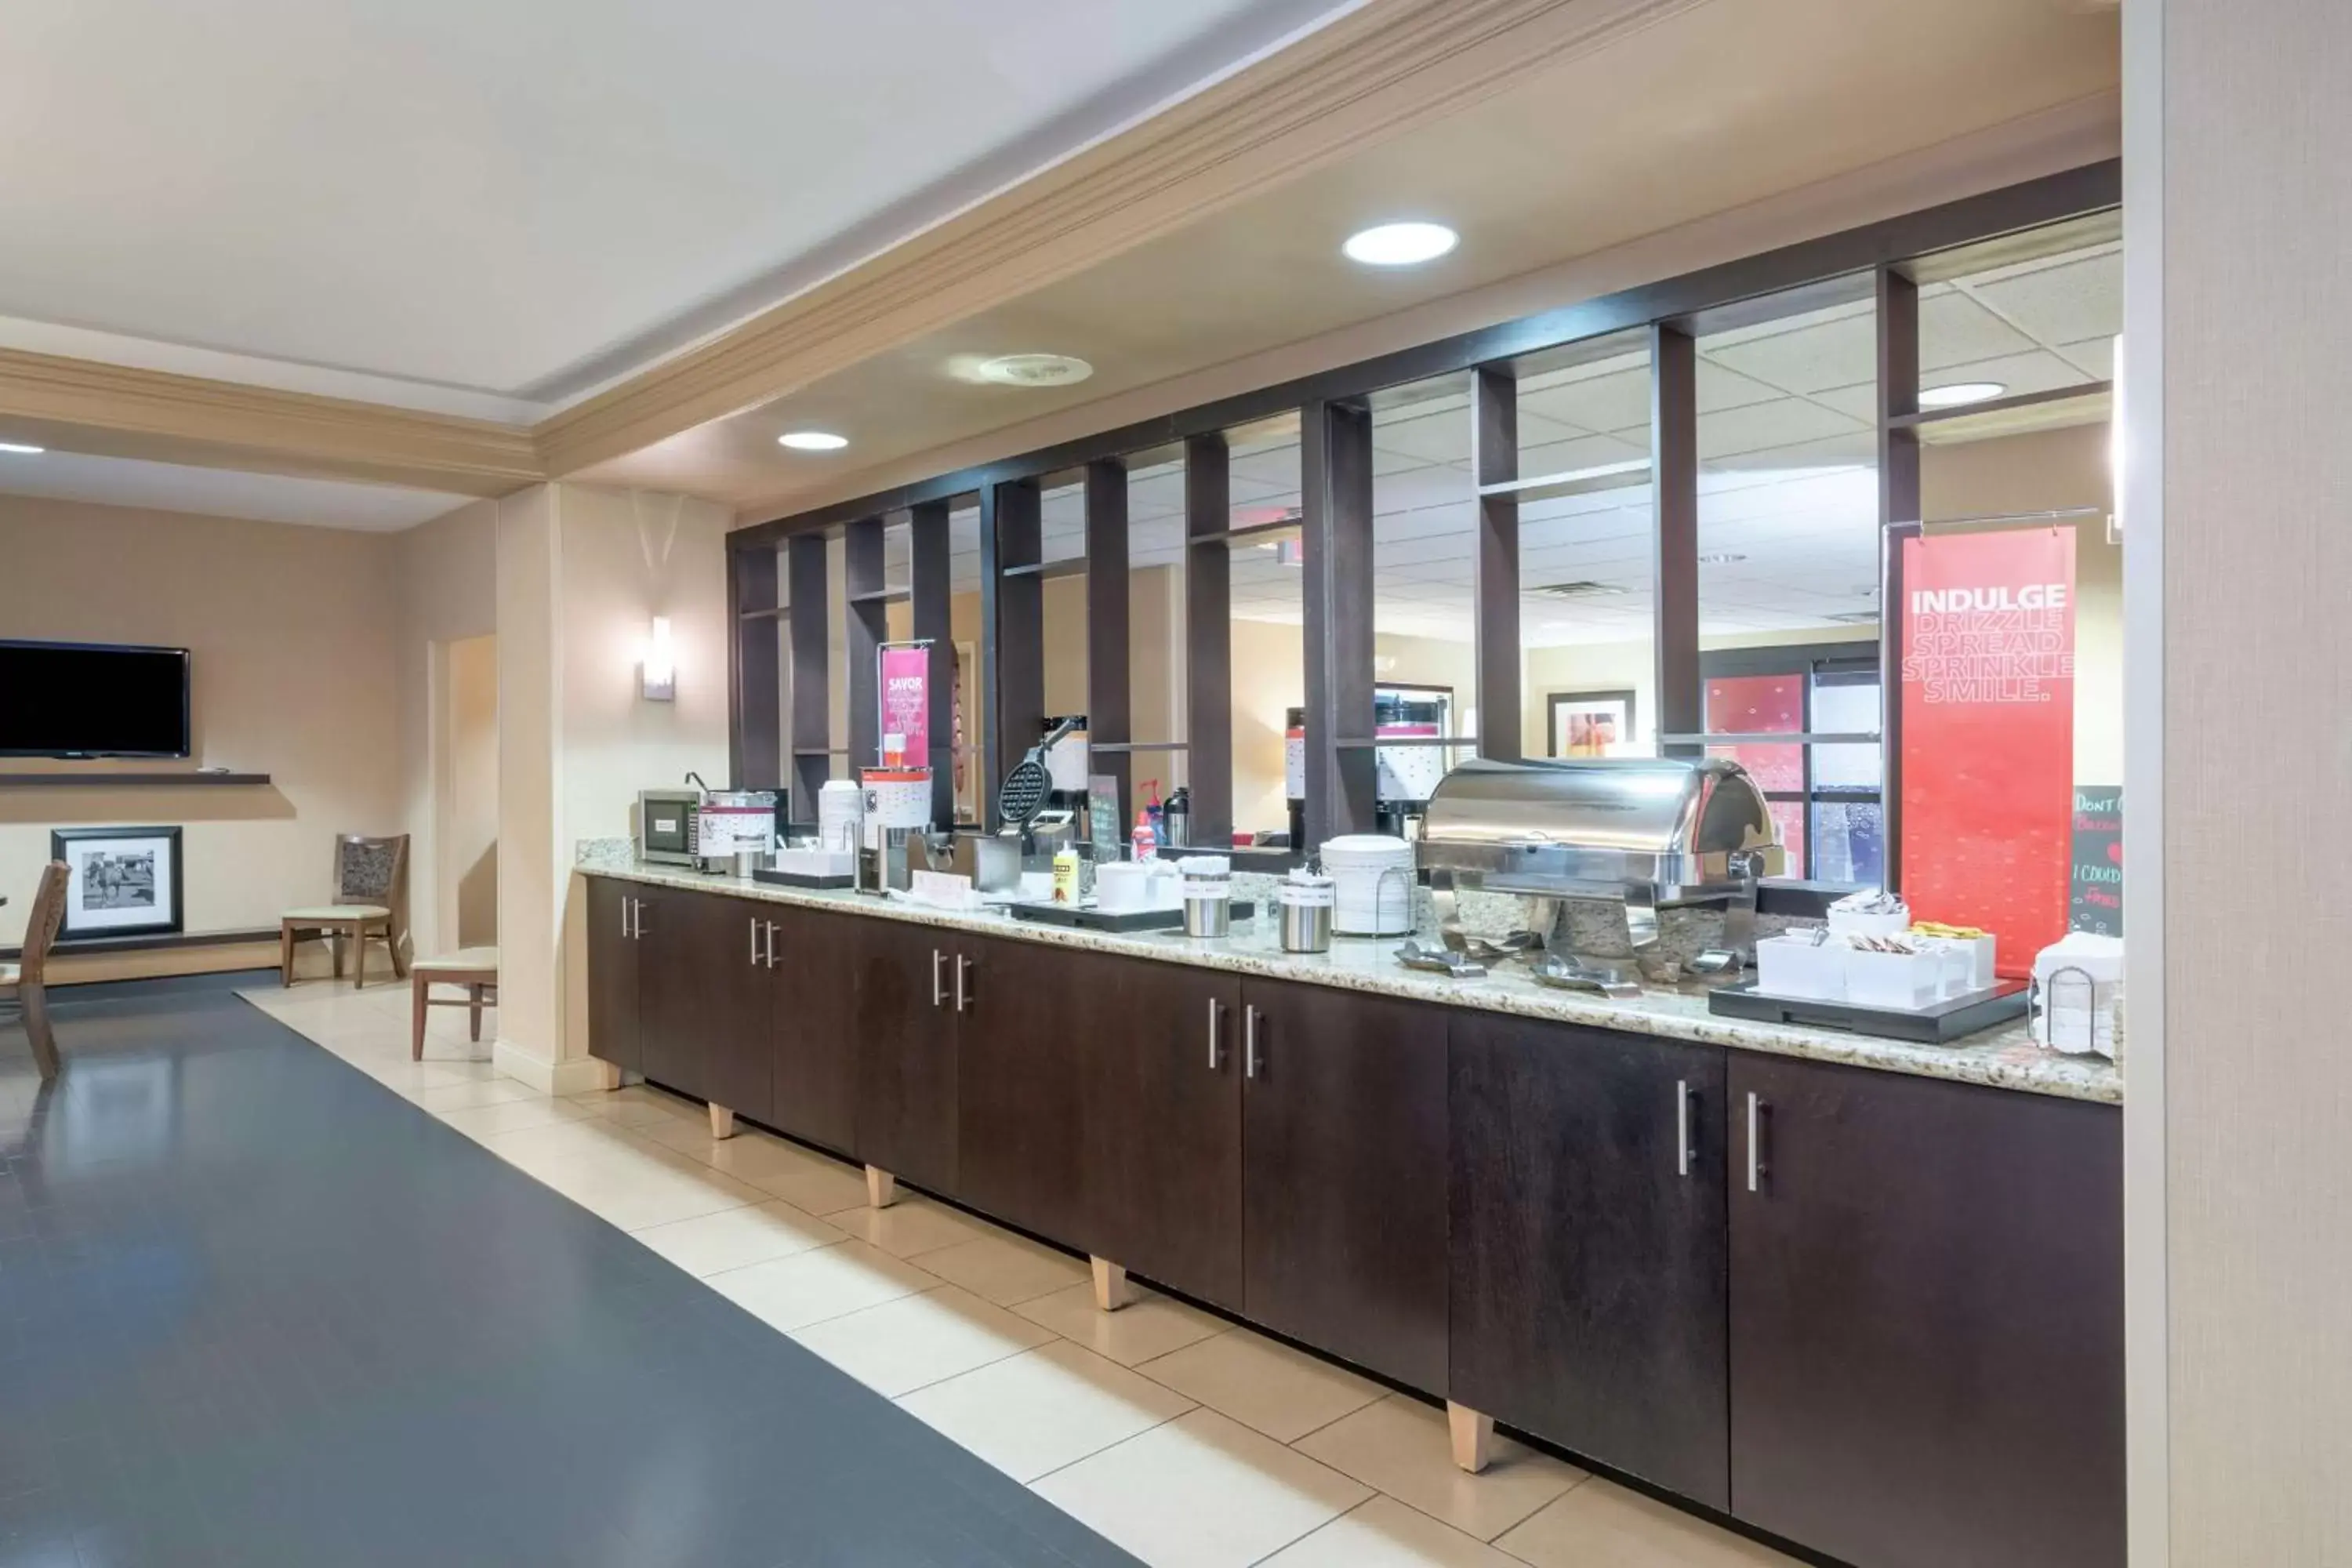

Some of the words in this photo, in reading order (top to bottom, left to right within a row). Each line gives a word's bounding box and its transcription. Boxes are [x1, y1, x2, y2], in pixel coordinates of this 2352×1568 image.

[1911, 584, 2067, 613] INDULGE
[1914, 609, 2064, 634] DRIZZLE
[1913, 631, 2064, 656] SPREAD
[1902, 653, 2076, 681] SPRINKLE
[888, 677, 923, 690] SAVOR
[1924, 677, 2051, 702] SMILE.
